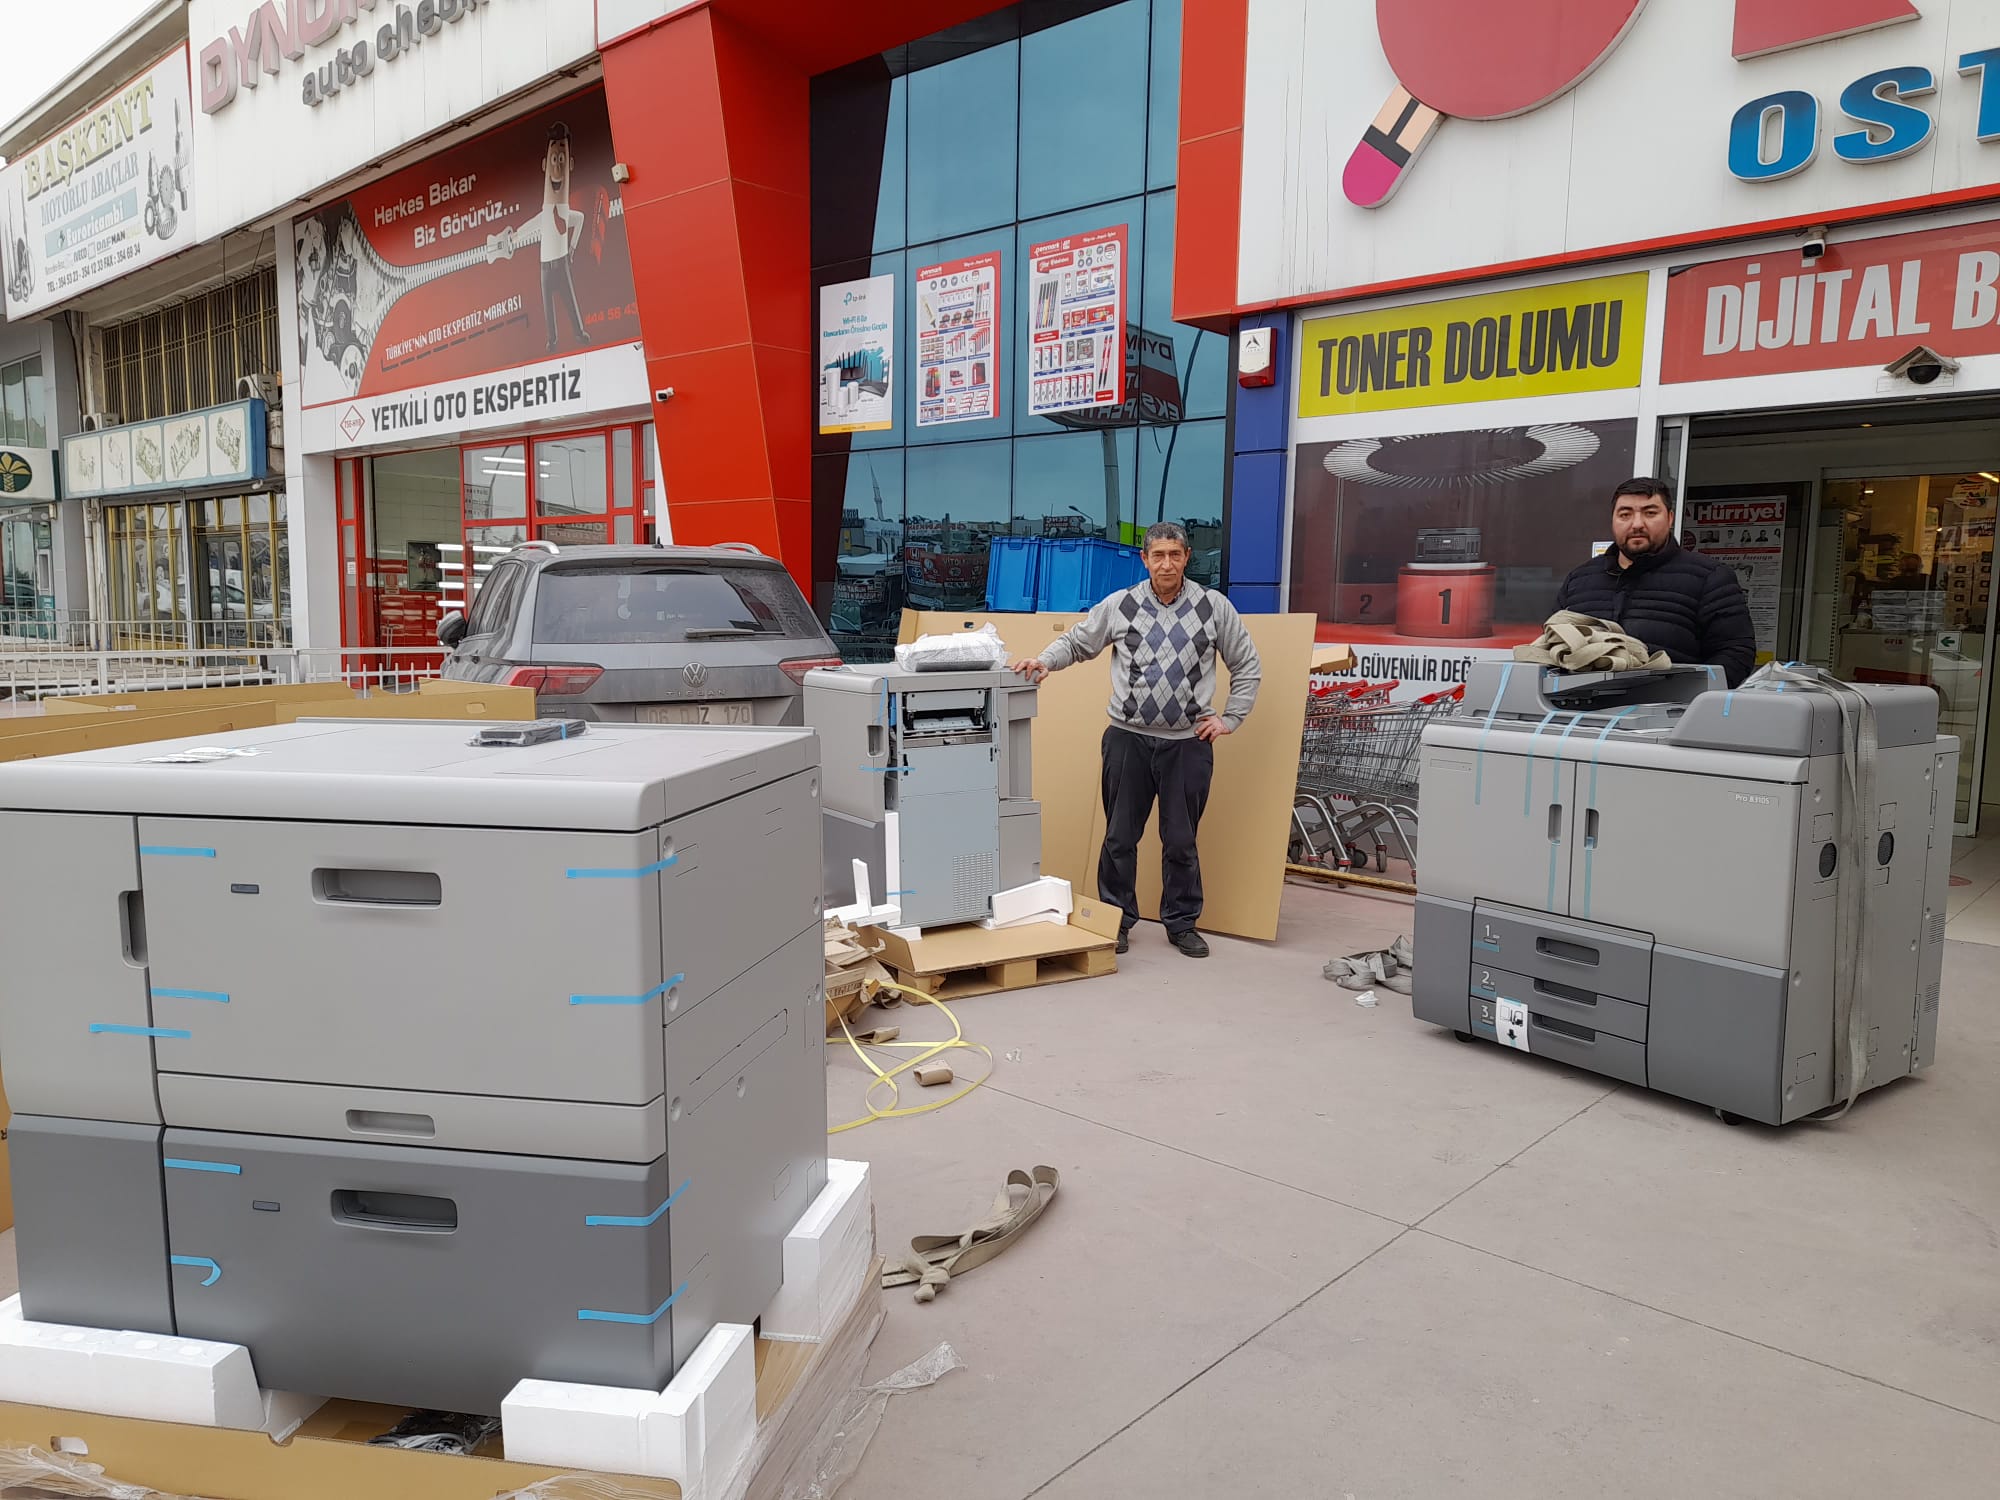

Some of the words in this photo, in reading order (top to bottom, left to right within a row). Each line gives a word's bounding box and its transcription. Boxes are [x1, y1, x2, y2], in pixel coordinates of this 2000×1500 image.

[302, 40, 375, 107] auto
[376, 0, 490, 62] chec
[25, 76, 154, 201] BAŞKENT
[40, 181, 88, 227] MOTORLU
[91, 151, 139, 201] ARAÇLAR
[374, 194, 424, 227] Herkes
[429, 173, 477, 206] Bakar
[414, 225, 436, 249] Biz
[440, 199, 520, 239] Görürüz...
[385, 331, 428, 360] TÜRKİYE'NİN
[428, 327, 442, 344] OTO
[442, 309, 482, 338] EKSPERTİZ
[483, 294, 522, 322] MARKASI
[1703, 258, 1930, 355] DİJİTAL
[1952, 250, 2000, 330] B
[1317, 325, 1433, 397] TONER
[1443, 299, 1623, 384] DOLUMU
[371, 391, 428, 432] YETKİLİ
[434, 391, 466, 422] OTO
[473, 363, 581, 416] EKSPERTİZ
[1698, 502, 1783, 522] Hürriyet
[1360, 594, 1373, 615] 2
[1438, 588, 1451, 625] 1
[1361, 652, 1437, 682] GÜVENİLİR
[1441, 656, 1477, 683] DEĞ
[1735, 794, 1748, 802] Pro
[1485, 924, 1490, 937] 1
[1482, 971, 1490, 984] 2
[1481, 1005, 1489, 1018] 3
